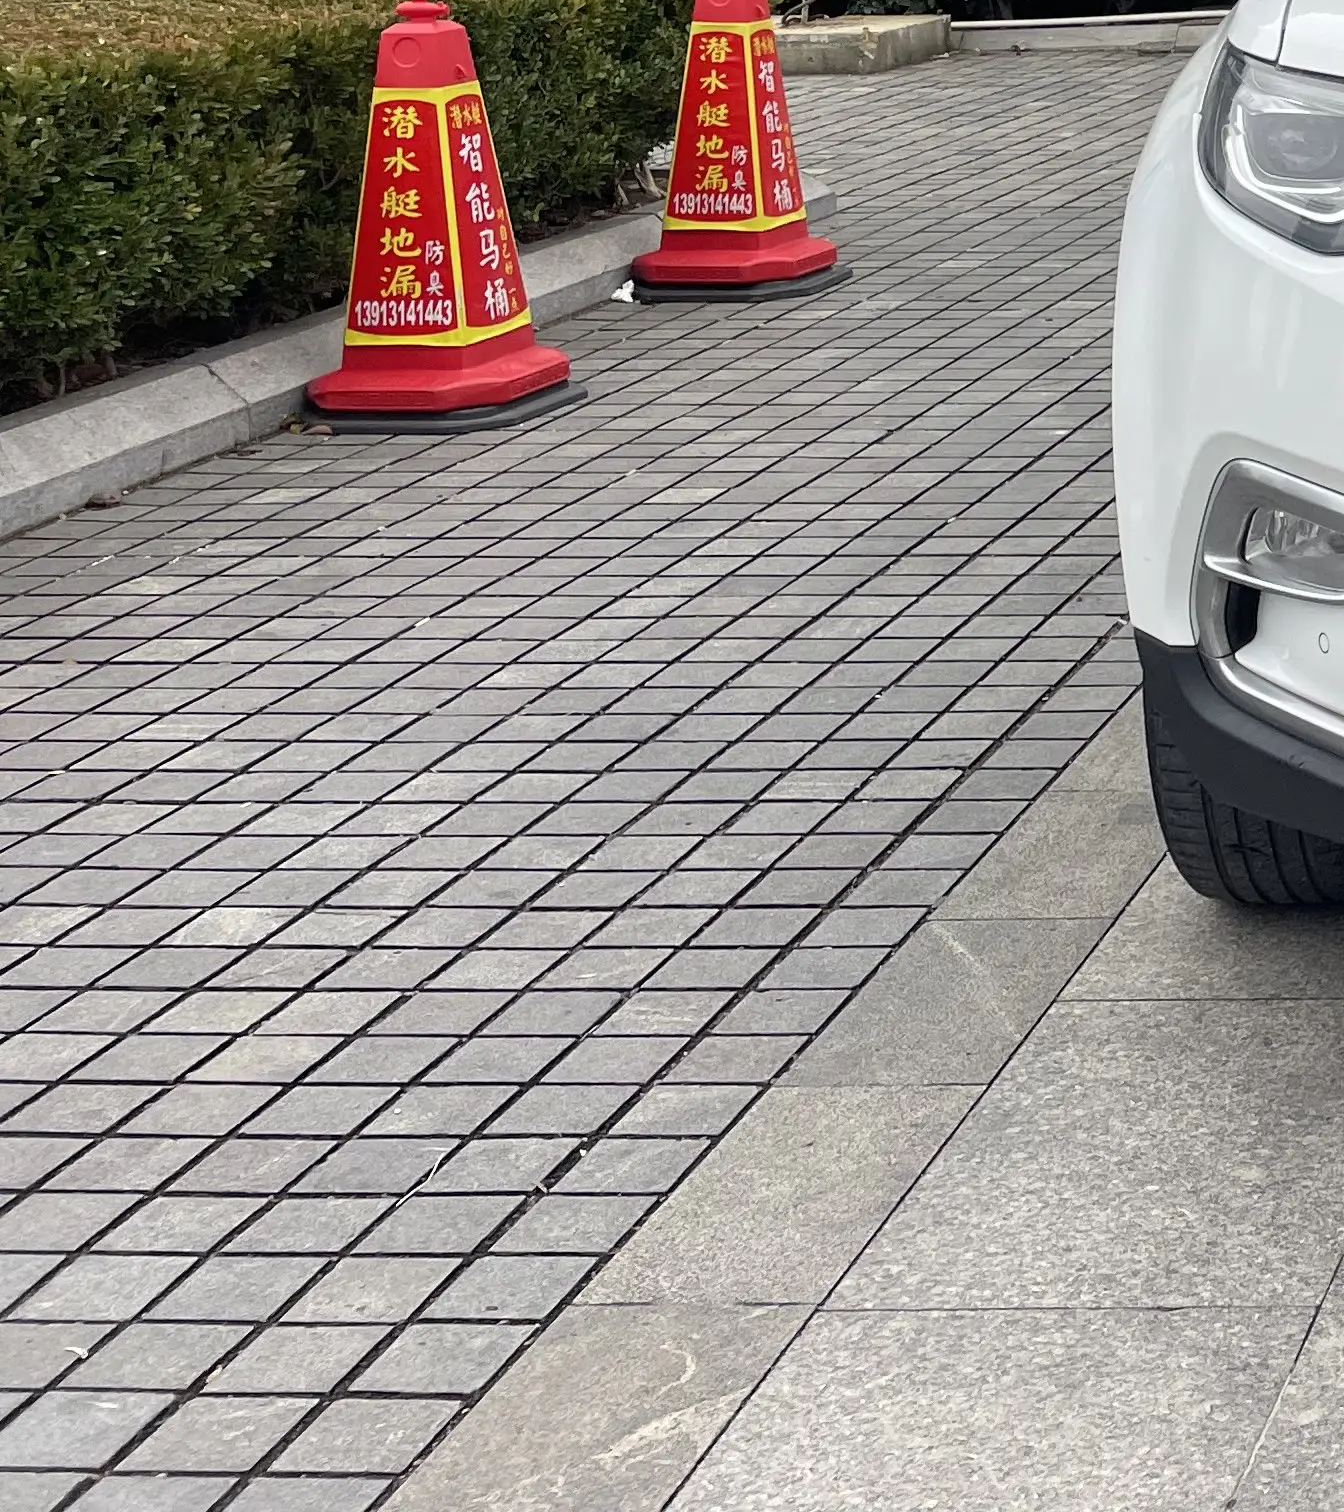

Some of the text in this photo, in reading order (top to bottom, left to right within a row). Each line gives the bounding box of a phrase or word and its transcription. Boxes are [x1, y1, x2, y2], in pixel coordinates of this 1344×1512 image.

[695, 36, 733, 193] 潜水艇地漏
[757, 60, 793, 212] 智能马桶
[379, 105, 424, 300] 潜水艇地漏
[673, 193, 753, 215] 13913141443
[731, 145, 749, 192] 防臭
[424, 239, 446, 297] 防臭
[458, 133, 510, 321] 智能马桶
[354, 299, 453, 327] 13913141443
